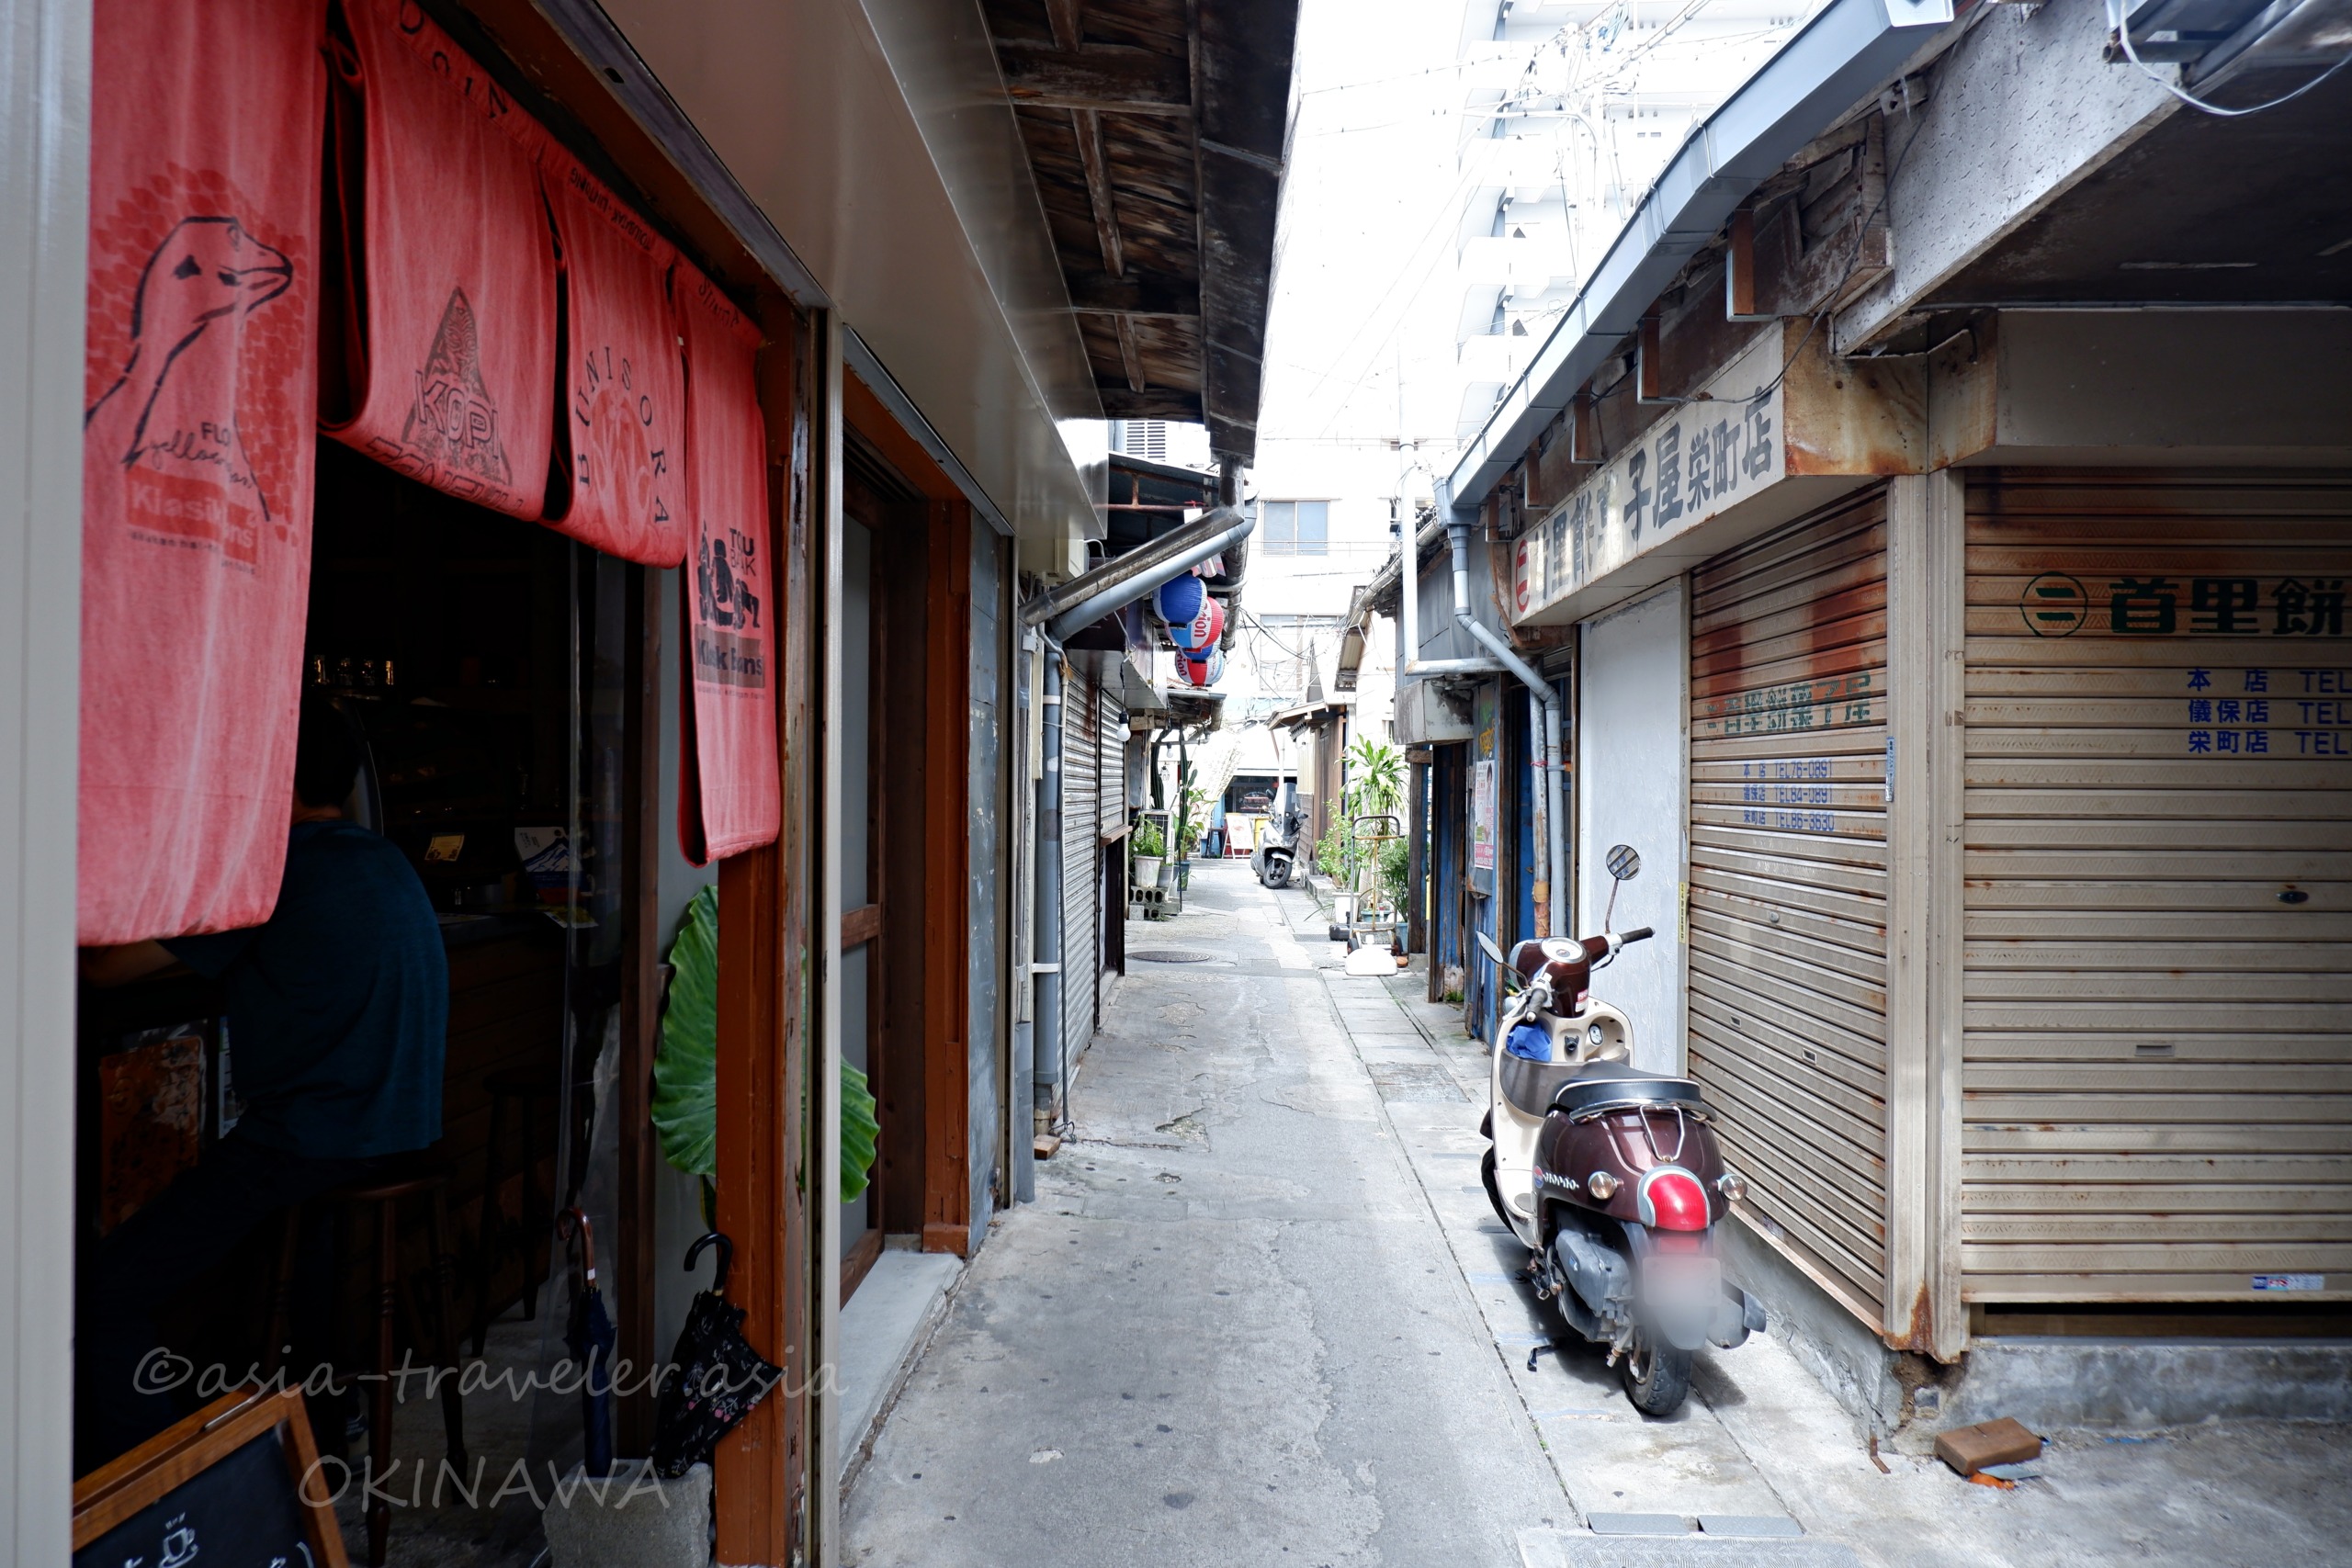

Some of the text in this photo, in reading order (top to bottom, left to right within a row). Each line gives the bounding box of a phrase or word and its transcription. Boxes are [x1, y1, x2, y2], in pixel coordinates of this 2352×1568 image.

[414, 369, 500, 459] KOPI
[2109, 577, 2346, 636] 首里餅
[2298, 670, 2352, 694] TEL
[2188, 699, 2352, 725] 儀保店 TEL
[2188, 729, 2349, 755] 栄町店 TEL
